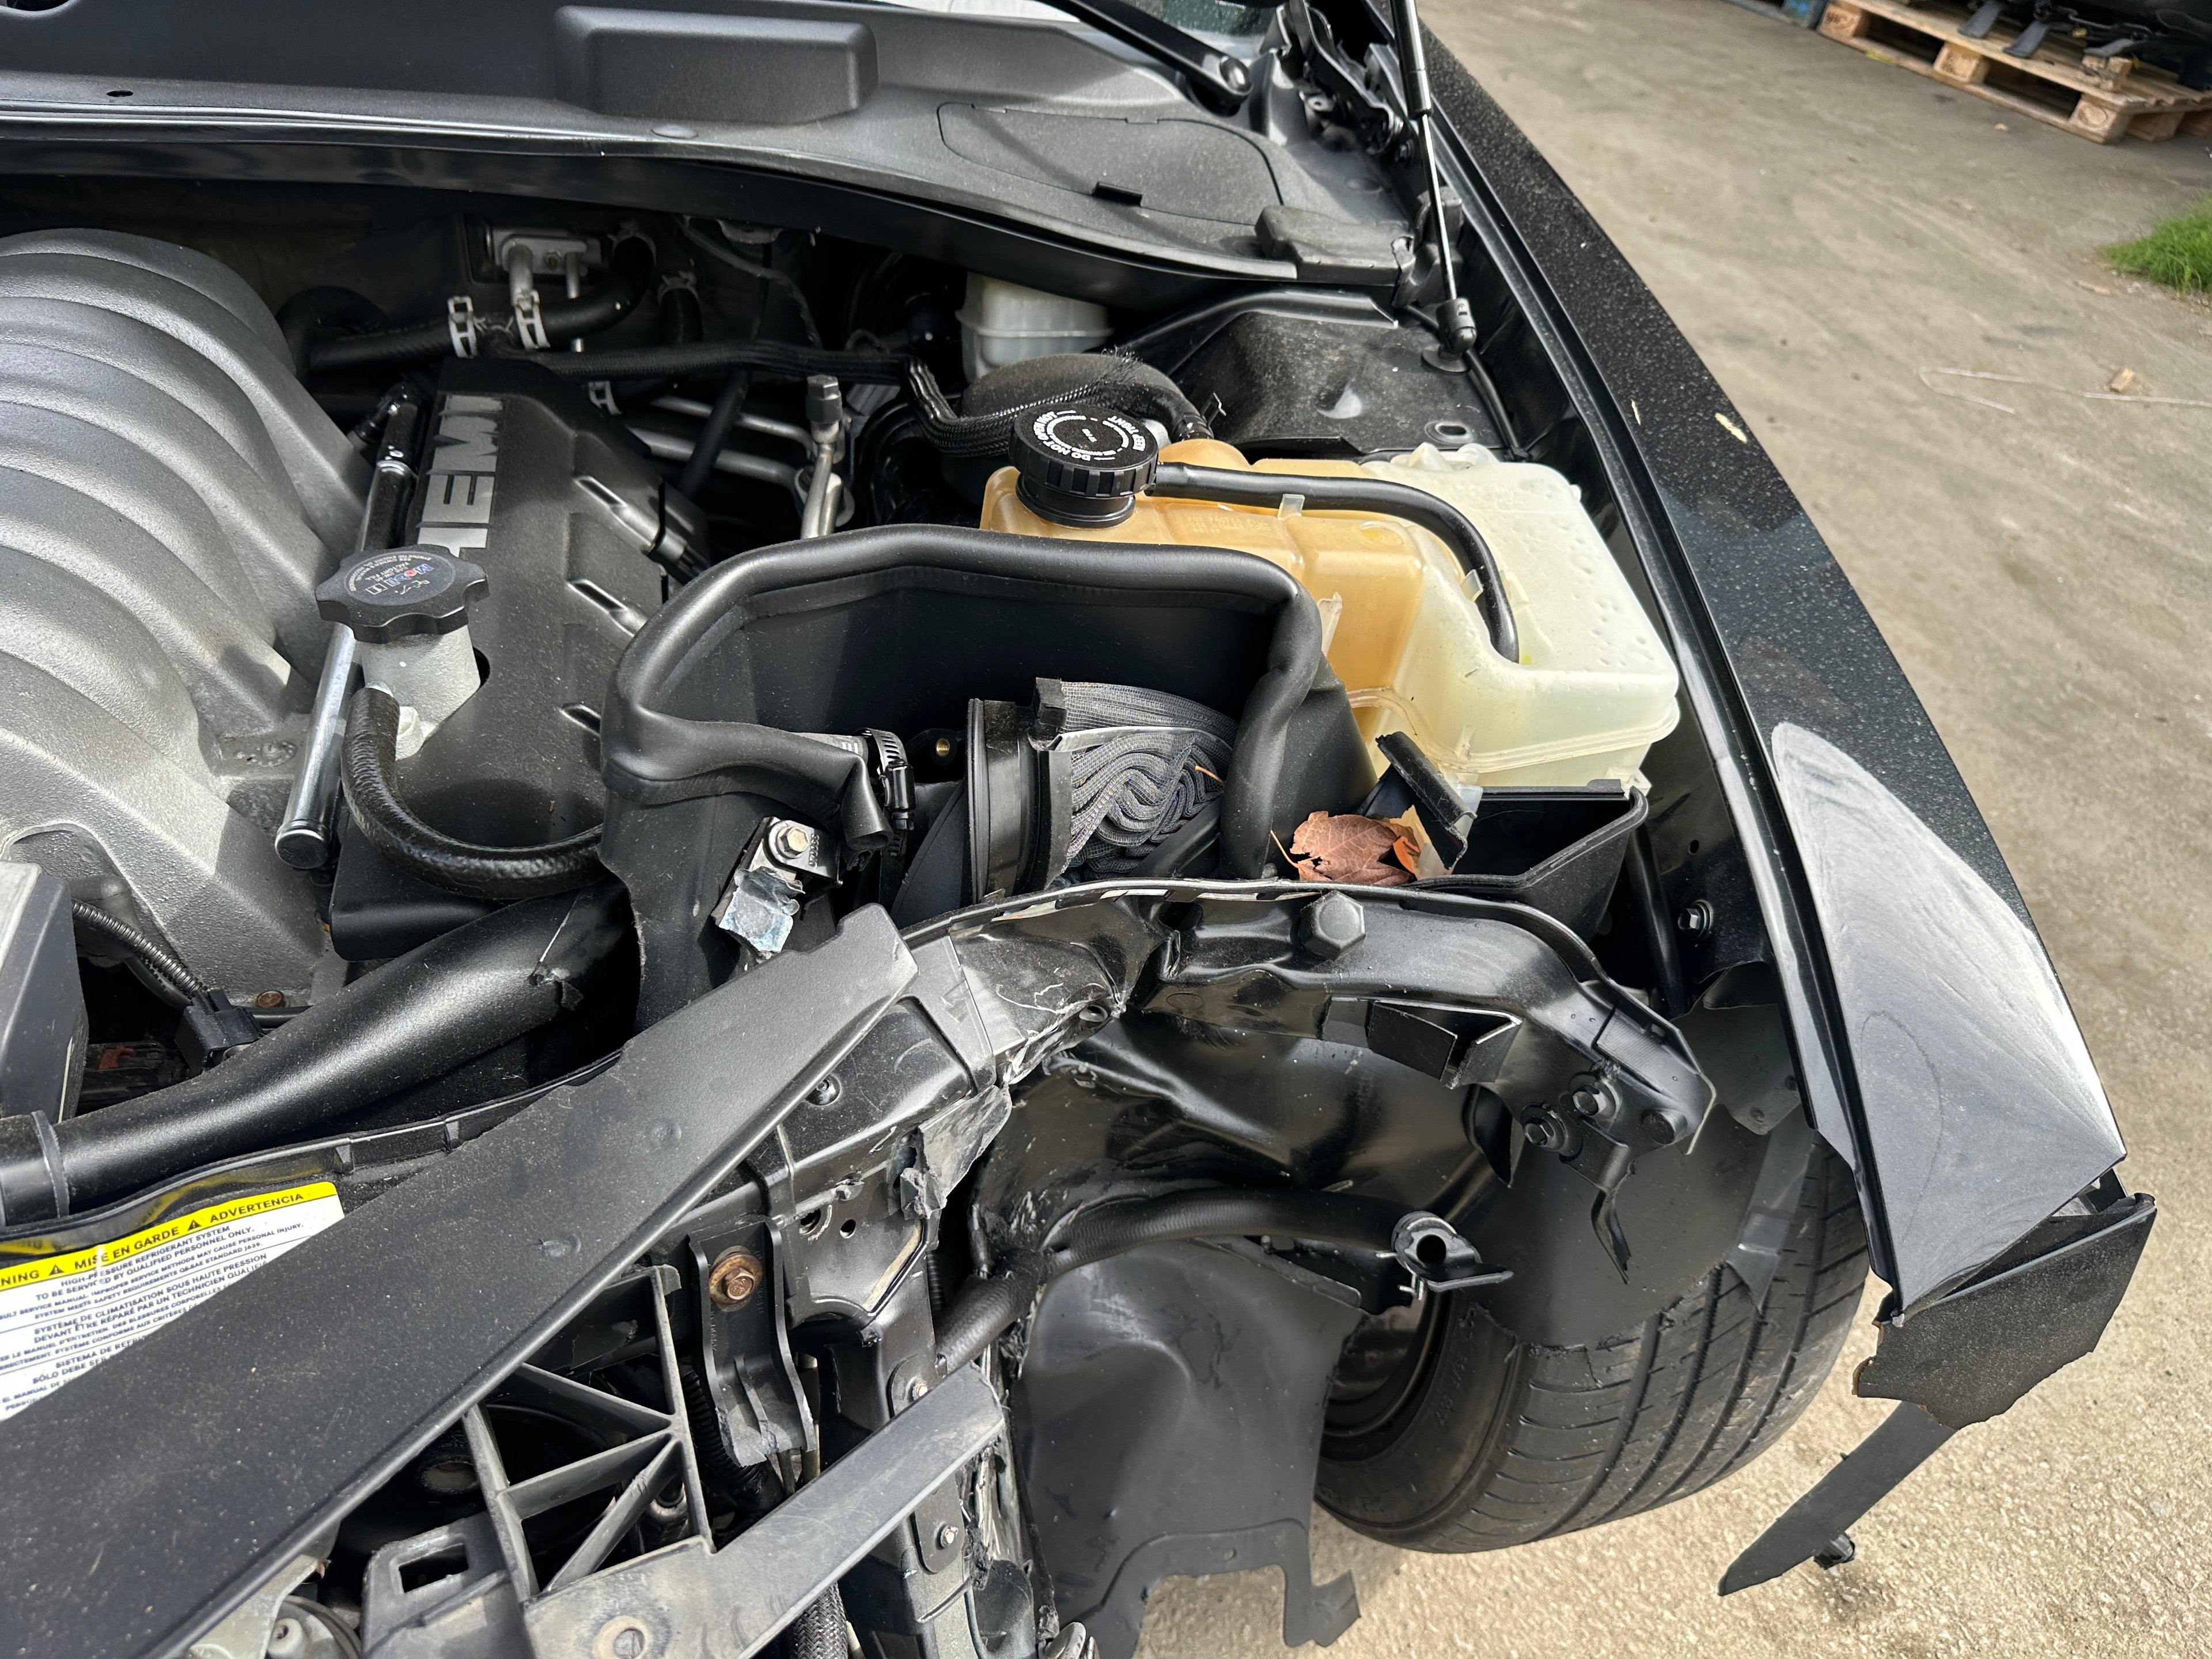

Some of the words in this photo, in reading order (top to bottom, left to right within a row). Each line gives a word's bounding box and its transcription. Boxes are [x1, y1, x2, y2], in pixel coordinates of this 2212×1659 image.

[1043, 441, 1071, 455] NOT
[1071, 452, 1091, 461] DO
[384, 563, 434, 587] Mobil
[0, 1270, 40, 1287] NING
[74, 1252, 110, 1270] MISE
[112, 1245, 131, 1259] EN
[134, 1226, 180, 1250] GARDE
[210, 1194, 304, 1223] ADVERTENCIA
[135, 1237, 194, 1264] REFRIGERANT
[196, 1225, 230, 1241] SYSTEM
[20, 1302, 52, 1315] SERVICE
[91, 1280, 128, 1296] IMPROPER
[131, 1269, 159, 1283] SERVICE
[161, 1256, 195, 1272] METHODS
[197, 1249, 211, 1259] MAY
[214, 1241, 237, 1252] CAUSE
[238, 1230, 275, 1244] PERSONAL
[277, 1223, 304, 1234] INJURY.
[36, 1293, 50, 1301] TO
[52, 1289, 64, 1298] BE
[66, 1277, 111, 1294] SERVICED
[113, 1271, 124, 1281] BY
[127, 1253, 172, 1275] QUALIFIED
[175, 1235, 226, 1257] PERSONNEL
[228, 1226, 255, 1238] ONLY.
[35, 1308, 65, 1319] SYSTEM
[67, 1300, 92, 1311] MEETS
[94, 1291, 122, 1304] SAFETY
[123, 1270, 177, 1294] REQUIREMENTS
[205, 1247, 243, 1264] STANDARD
[81, 1313, 92, 1322] DE
[95, 1289, 164, 1318] CLIMATISATION
[166, 1279, 190, 1293] SOUS
[192, 1268, 222, 1284] HAUTE
[224, 1253, 267, 1272] PRESSION
[35, 1328, 73, 1343] DEVANT
[138, 1301, 154, 1312] PAR
[157, 1295, 170, 1305] UN
[172, 1275, 225, 1299] TECHNICIEN
[129, 1305, 169, 1323] BLESSURES
[171, 1286, 222, 1308] CORPORELLES
[92, 1325, 135, 1344] CONFORME
[56, 1350, 97, 1369] SISTEMA
[100, 1346, 112, 1355] DE
[62, 1362, 87, 1376] DEBE
